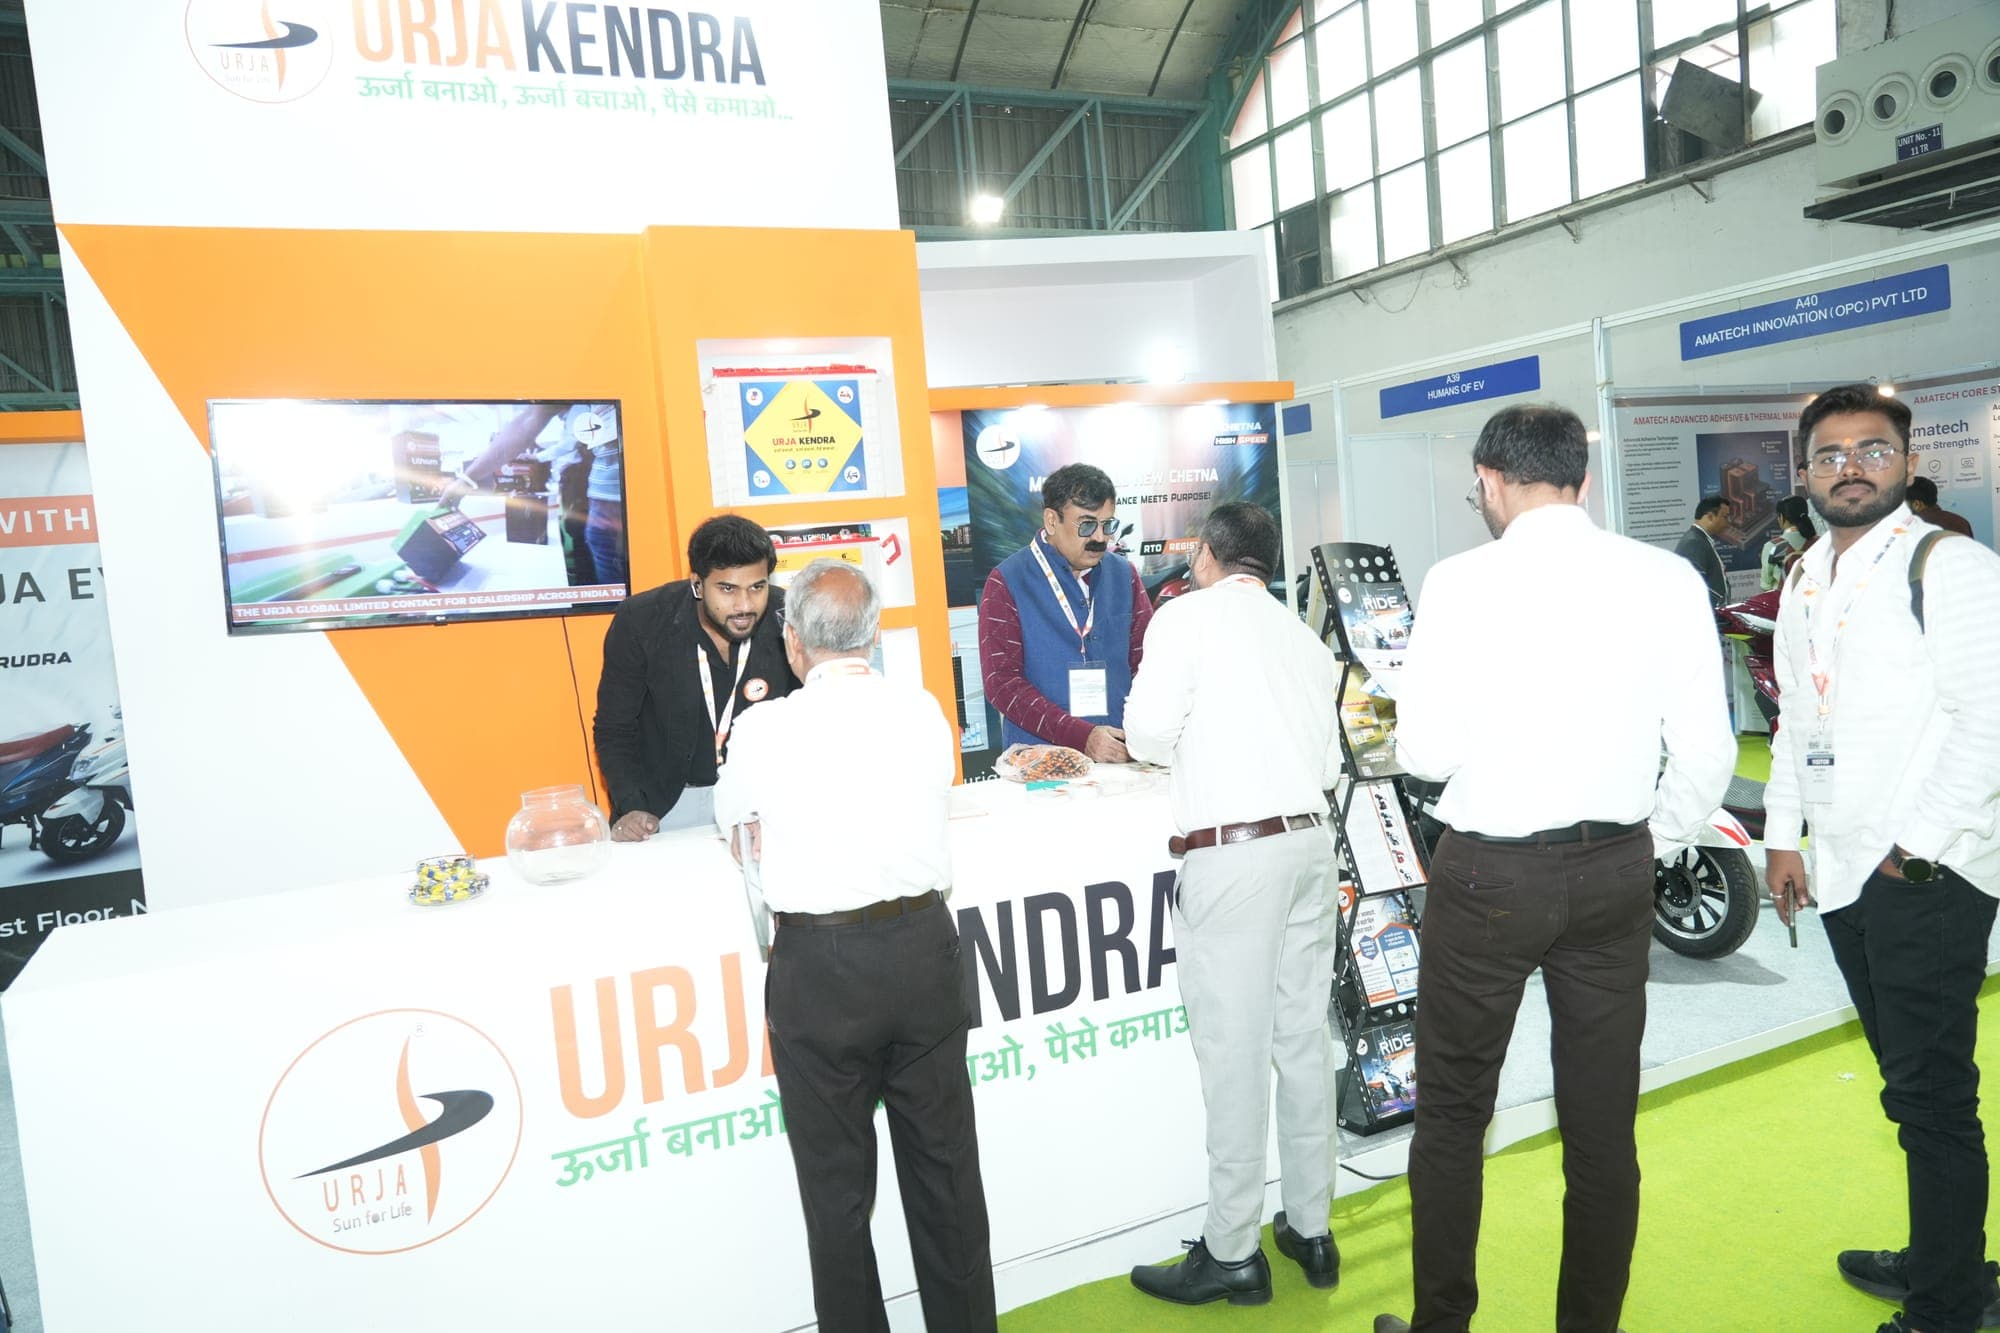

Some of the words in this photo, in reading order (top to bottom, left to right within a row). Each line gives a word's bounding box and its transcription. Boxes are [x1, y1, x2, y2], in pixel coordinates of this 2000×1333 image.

[1898, 135, 1915, 147] UNIT
[1795, 294, 1818, 309] A40
[1695, 326, 1750, 347] AMATECH
[1752, 310, 1828, 335] INNOVATION
[1872, 292, 1899, 310] PVT
[1901, 287, 1928, 304] LTD
[1446, 373, 1460, 384] A39
[1427, 385, 1460, 400] HUMANS
[1461, 383, 1472, 394] OF
[1473, 380, 1485, 391] EV
[1914, 391, 1959, 404] AMATECH
[1962, 387, 1989, 399] CORE
[1633, 415, 1668, 425] AMATECH
[1670, 414, 1709, 424] ADVANCED
[1710, 413, 1745, 423] ADHESIVE
[1751, 412, 1782, 421] THERMAL
[1909, 420, 1969, 438] matech
[772, 437, 797, 446] URJA
[799, 436, 836, 445] KENDRA
[1910, 443, 1931, 452] Core
[1933, 437, 1980, 449] Strengths
[1168, 467, 1219, 483] CHETNA
[1116, 496, 1137, 505] ANCE
[1141, 494, 1168, 504] MEETS
[1171, 491, 1211, 502] PURPOSE!
[1143, 543, 1162, 553] RTO
[235, 606, 260, 618] THE
[262, 605, 294, 616] URJA
[296, 604, 342, 614] GLOBAL
[344, 601, 390, 613] LIMITED
[392, 598, 443, 610] CONTACT
[445, 596, 467, 606] FOR
[469, 593, 535, 605] DEALERSHIP
[537, 591, 578, 602] ACROSS
[580, 589, 609, 600] INDIA
[1362, 595, 1401, 611] RIDE
[37, 906, 121, 933] Floor
[550, 952, 776, 1119] URJ
[957, 869, 1177, 1030] NDRA
[1379, 1033, 1415, 1055] RIDE
[551, 1116, 650, 1187] ऊर्जा
[1045, 1016, 1099, 1064] पैसे
[323, 1163, 408, 1213] URJA
[333, 1213, 362, 1233] Sun
[366, 1210, 388, 1225] for
[390, 1203, 413, 1220] Life
